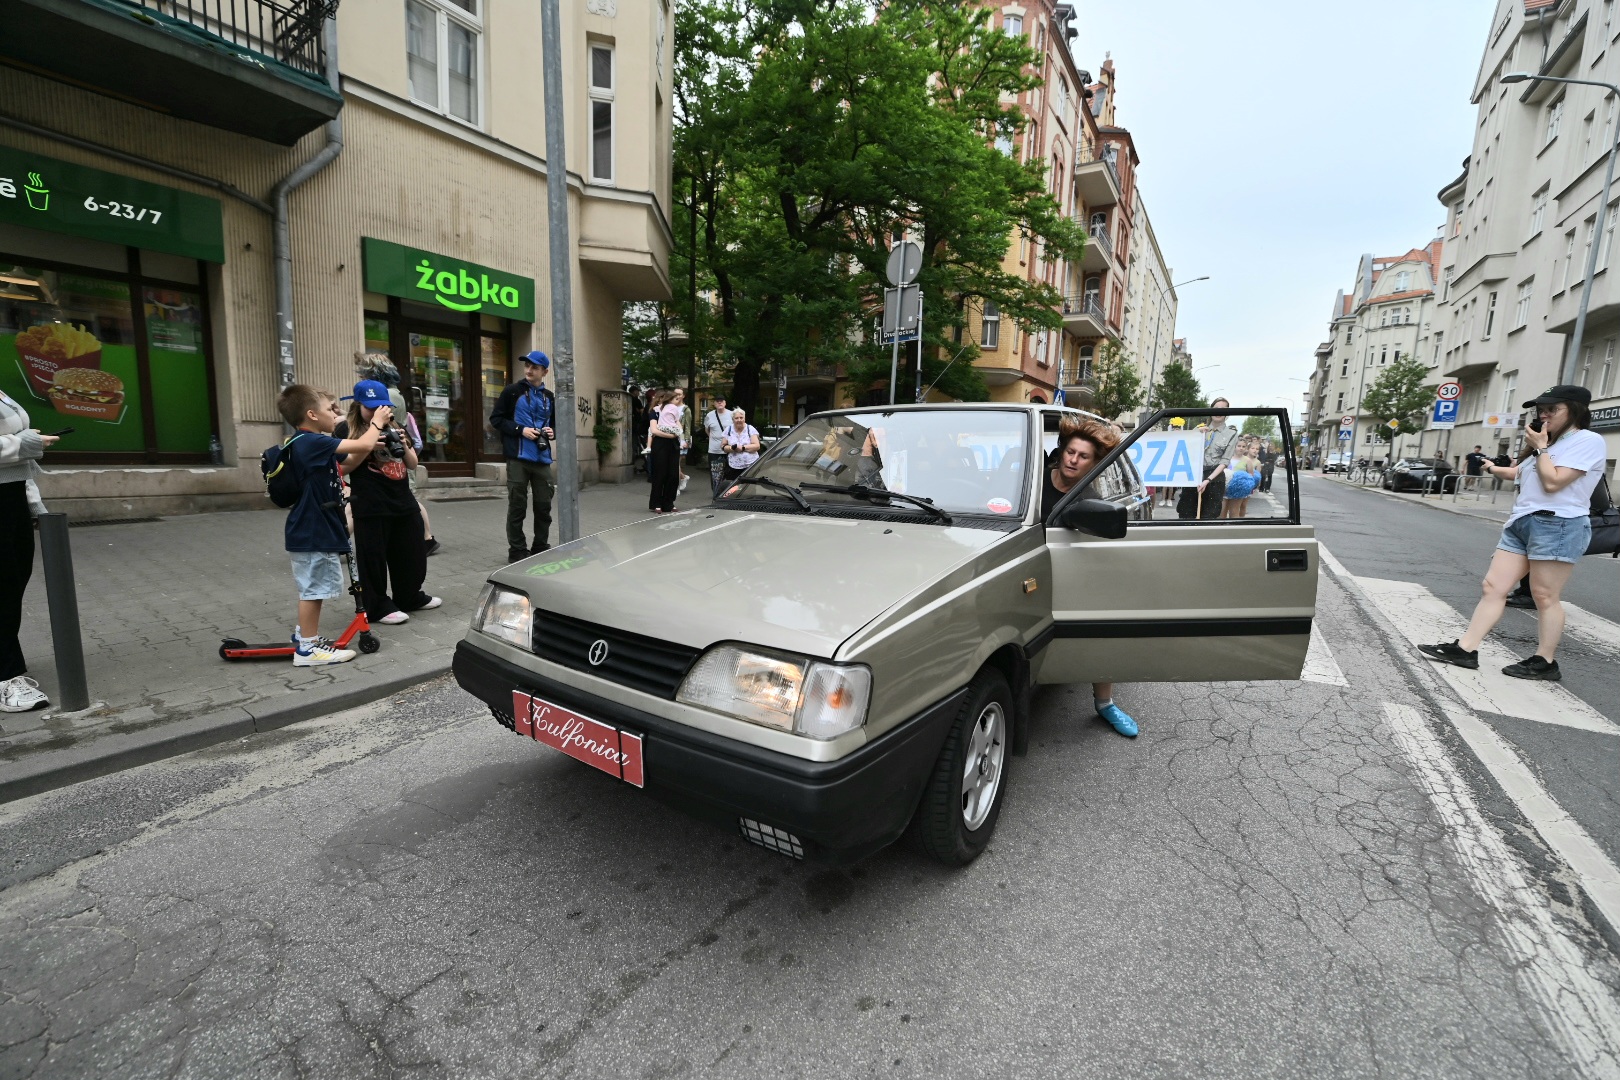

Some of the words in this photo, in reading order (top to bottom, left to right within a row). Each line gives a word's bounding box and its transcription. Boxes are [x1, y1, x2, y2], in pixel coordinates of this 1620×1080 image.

[84, 196, 162, 225] 6-23/7
[415, 259, 519, 309] żabka
[1441, 386, 1458, 396] 30
[1438, 402, 1455, 416] P
[522, 701, 631, 766] Kulfonica
